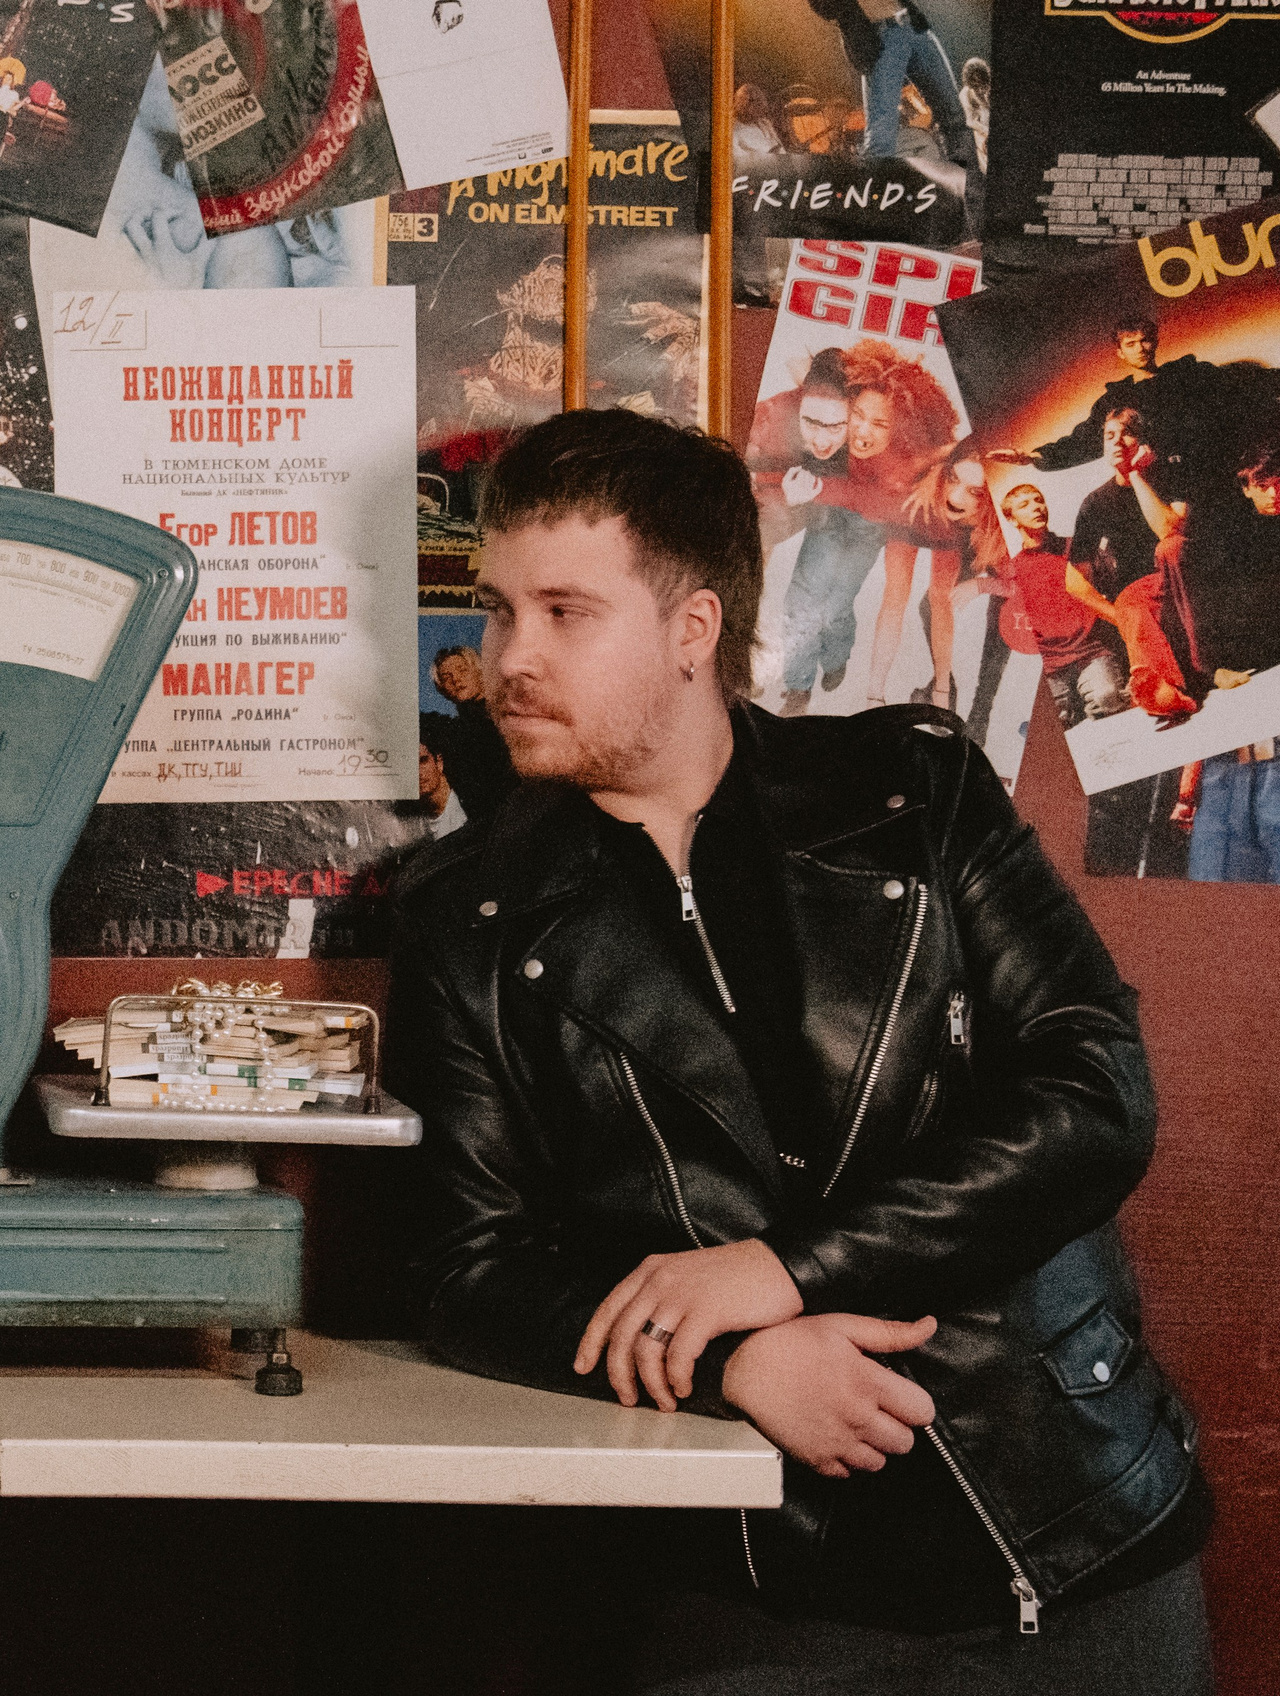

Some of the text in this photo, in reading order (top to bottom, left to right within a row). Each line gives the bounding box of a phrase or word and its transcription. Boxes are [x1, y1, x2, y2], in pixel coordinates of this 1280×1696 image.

[1136, 70, 1192, 81] An Adventure
[1101, 82, 1112, 92] 65
[1113, 82, 1143, 92] Million
[1144, 83, 1165, 93] Years
[1166, 83, 1175, 93] In
[1177, 83, 1192, 93] The
[468, 202, 510, 224] ON
[417, 216, 434, 237] 3
[1137, 213, 1280, 299] blur
[122, 358, 355, 405] НЕОЖИДАННЫЙ
[169, 407, 306, 447] КОНЦЕРТ
[144, 457, 328, 471] В ТЮМЕНСКОМ ДОМЕ
[122, 471, 350, 486] НАЦИОНАЛЬНЫХ КУЛЬТУР
[228, 511, 318, 546] ЛЕТОВ
[16, 551, 32, 566] 700
[217, 586, 348, 622] НЕУМОЕВ
[225, 634, 242, 646] ПО
[161, 661, 315, 697] МАНАГЕР
[173, 708, 222, 723] ГРУППА
